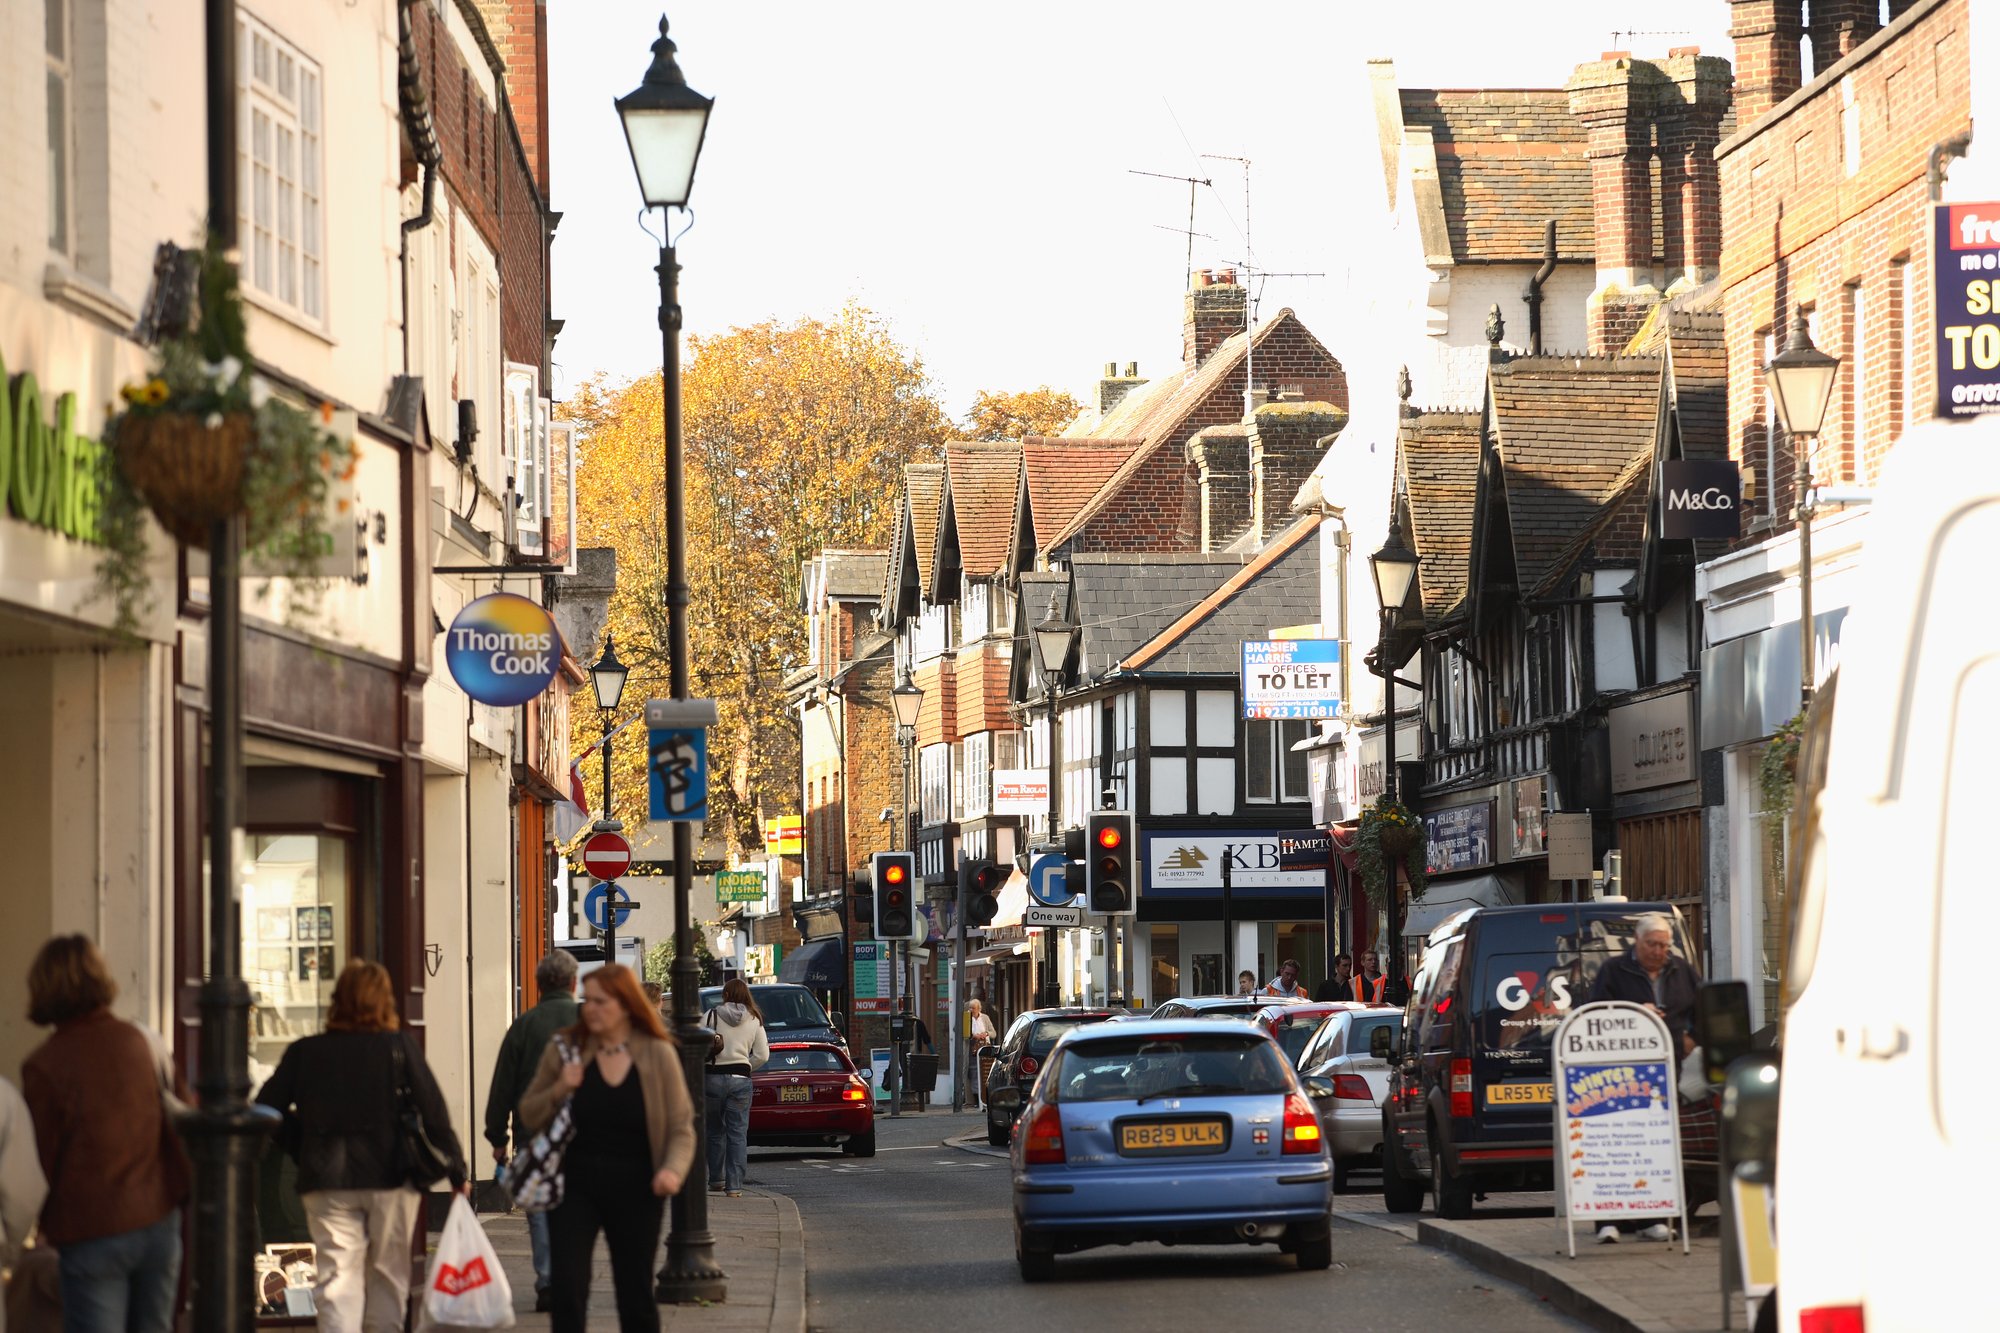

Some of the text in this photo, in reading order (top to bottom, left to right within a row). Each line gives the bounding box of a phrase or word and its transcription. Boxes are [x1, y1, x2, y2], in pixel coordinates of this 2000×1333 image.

[1944, 323, 2000, 370] TO
[452, 628, 552, 651] Thomas
[1245, 642, 1298, 652] BRASIER
[490, 651, 551, 675] Cook
[1245, 653, 1292, 663] HARRIS
[1272, 664, 1317, 673] OFFICES
[1258, 673, 1331, 690] TO LET
[1246, 706, 1289, 718] 01923
[998, 784, 1047, 794] PETER REGLAR
[719, 874, 761, 886] INDIAN
[719, 886, 761, 894] CUISINE
[1031, 912, 1076, 923] One way
[855, 1001, 877, 1009] NOW
[1500, 1019, 1525, 1027] Group
[1587, 1018, 1637, 1036] HOME
[1569, 1035, 1658, 1053] BAKERIES
[1570, 1066, 1636, 1095] WINTER
[1494, 1086, 1554, 1101] LR55 YS
[1567, 1081, 1651, 1116] WARMERS
[1125, 1126, 1220, 1145] R829 ULK
[1594, 1201, 1623, 1210] WARM
[1628, 1200, 1674, 1209] WELCOME
